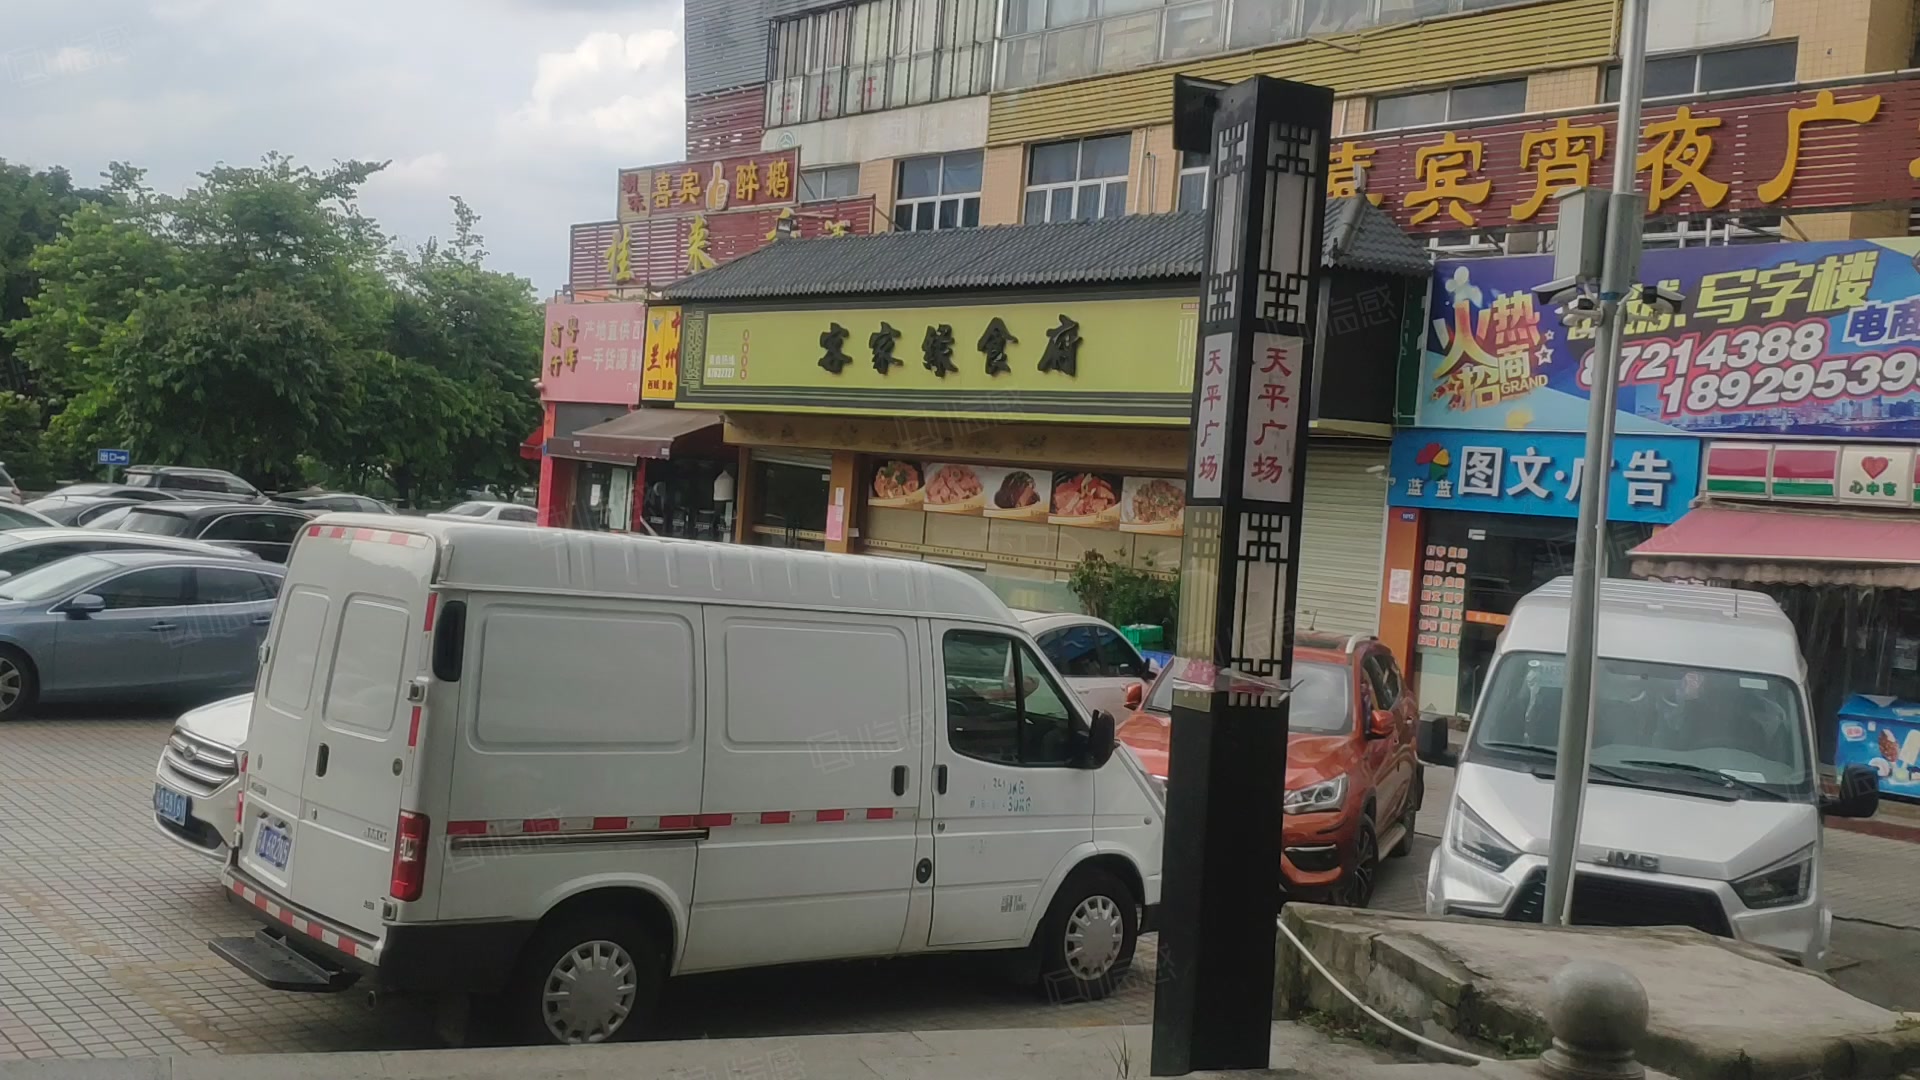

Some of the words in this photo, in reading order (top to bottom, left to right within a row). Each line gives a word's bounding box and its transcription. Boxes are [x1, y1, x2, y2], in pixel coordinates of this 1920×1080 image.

[1327, 89, 1920, 226] 喜宾宵夜广
[1198, 349, 1225, 483] 天平广场
[1252, 346, 1293, 485] 天平广场
[1501, 374, 1549, 395] GRAND
[1660, 352, 1920, 415] 18929539
[1407, 478, 1453, 499] 蓝蓝
